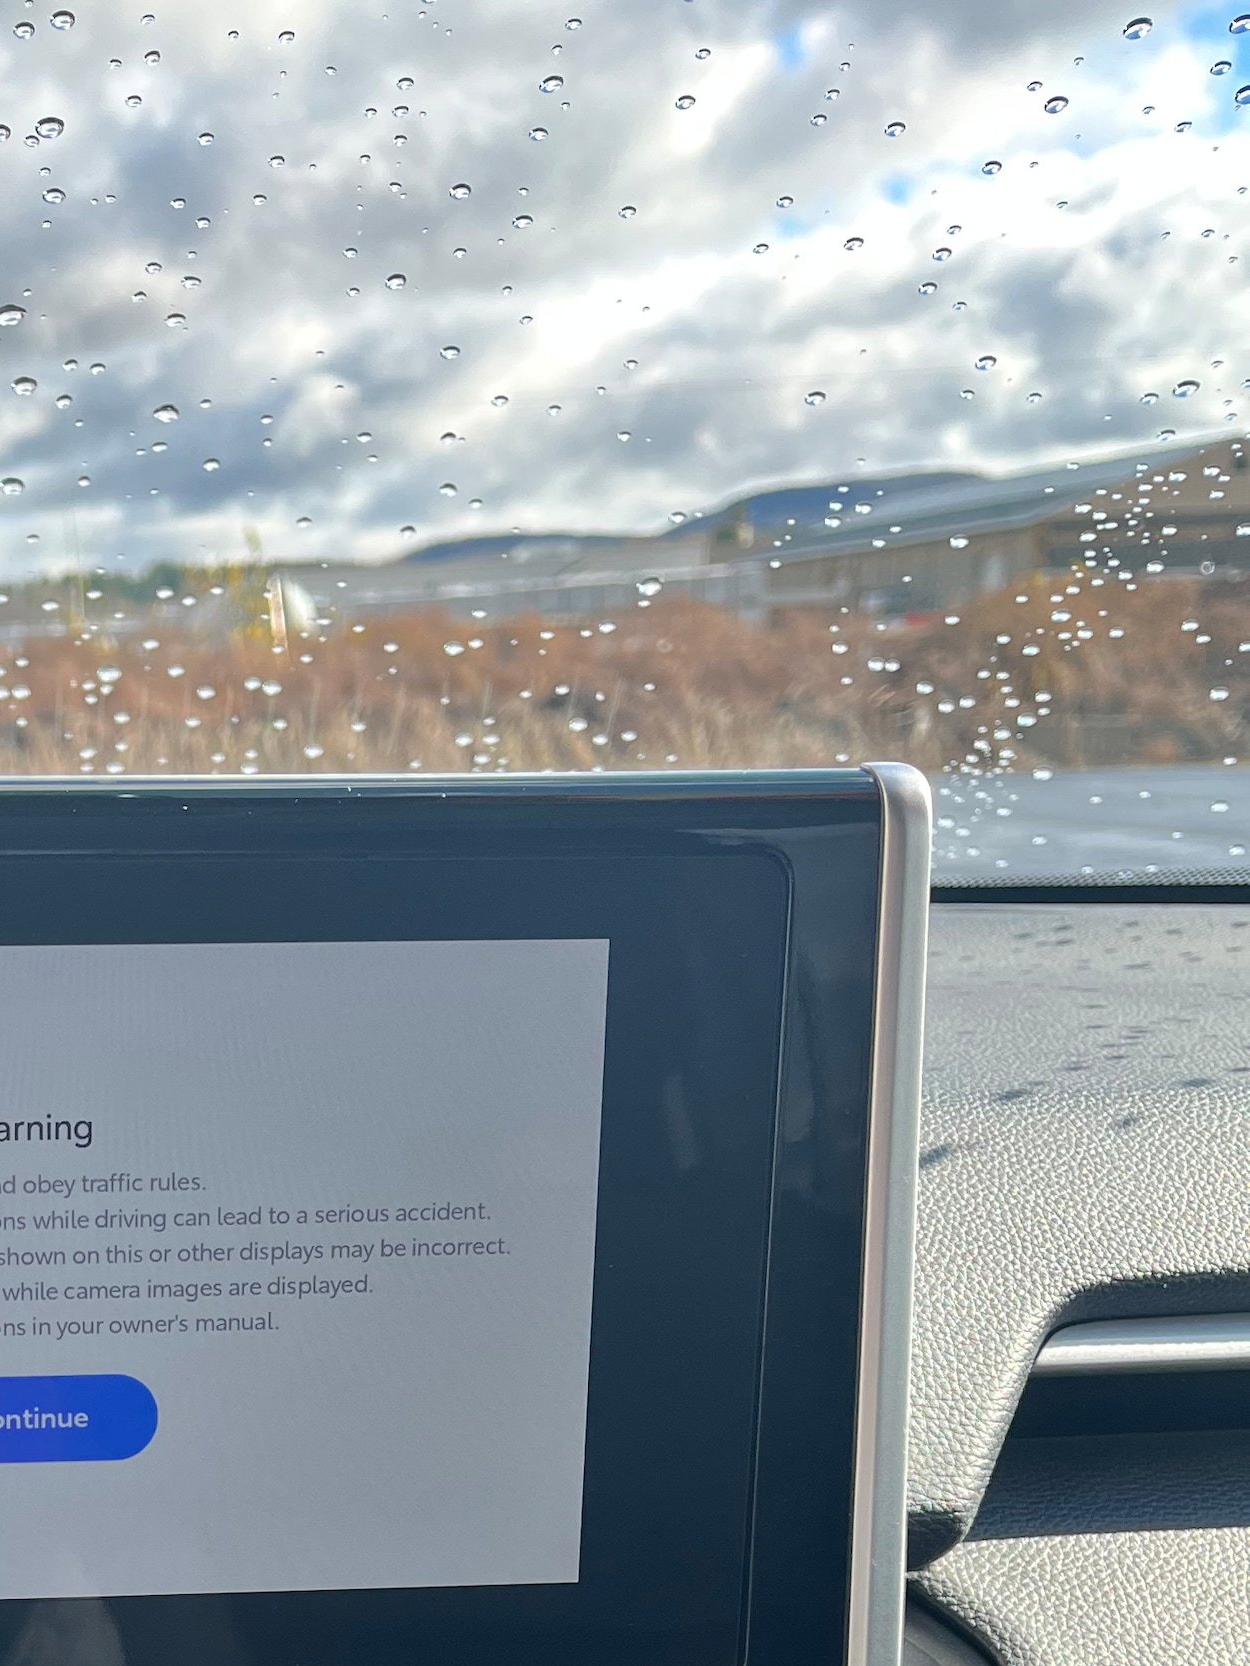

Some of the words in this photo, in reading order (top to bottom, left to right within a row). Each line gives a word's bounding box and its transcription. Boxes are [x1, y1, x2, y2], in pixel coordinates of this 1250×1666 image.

[22, 1173, 76, 1199] obey
[81, 1172, 143, 1193] traffic
[150, 1171, 207, 1192] rules.
[32, 1209, 90, 1230] while
[94, 1208, 167, 1233] driving
[173, 1212, 211, 1227] can
[217, 1205, 262, 1226] lead
[268, 1207, 290, 1225] to
[295, 1209, 308, 1225] a
[314, 1203, 390, 1224] serious
[395, 1201, 491, 1222] accident.
[72, 1250, 100, 1265] on
[105, 1244, 143, 1264] this
[149, 1248, 172, 1263] or
[177, 1242, 235, 1263] other
[239, 1240, 324, 1266] displays
[330, 1243, 375, 1264] may
[380, 1238, 407, 1258] be
[411, 1237, 511, 1257] incorrect.
[1, 1281, 59, 1302] while
[63, 1284, 141, 1300] camera
[147, 1278, 223, 1303] images
[228, 1281, 262, 1297] are
[266, 1273, 374, 1300] displayed.
[32, 1316, 52, 1336] in
[56, 1320, 105, 1341] your
[108, 1314, 189, 1334] owner's
[195, 1311, 280, 1333] manual.
